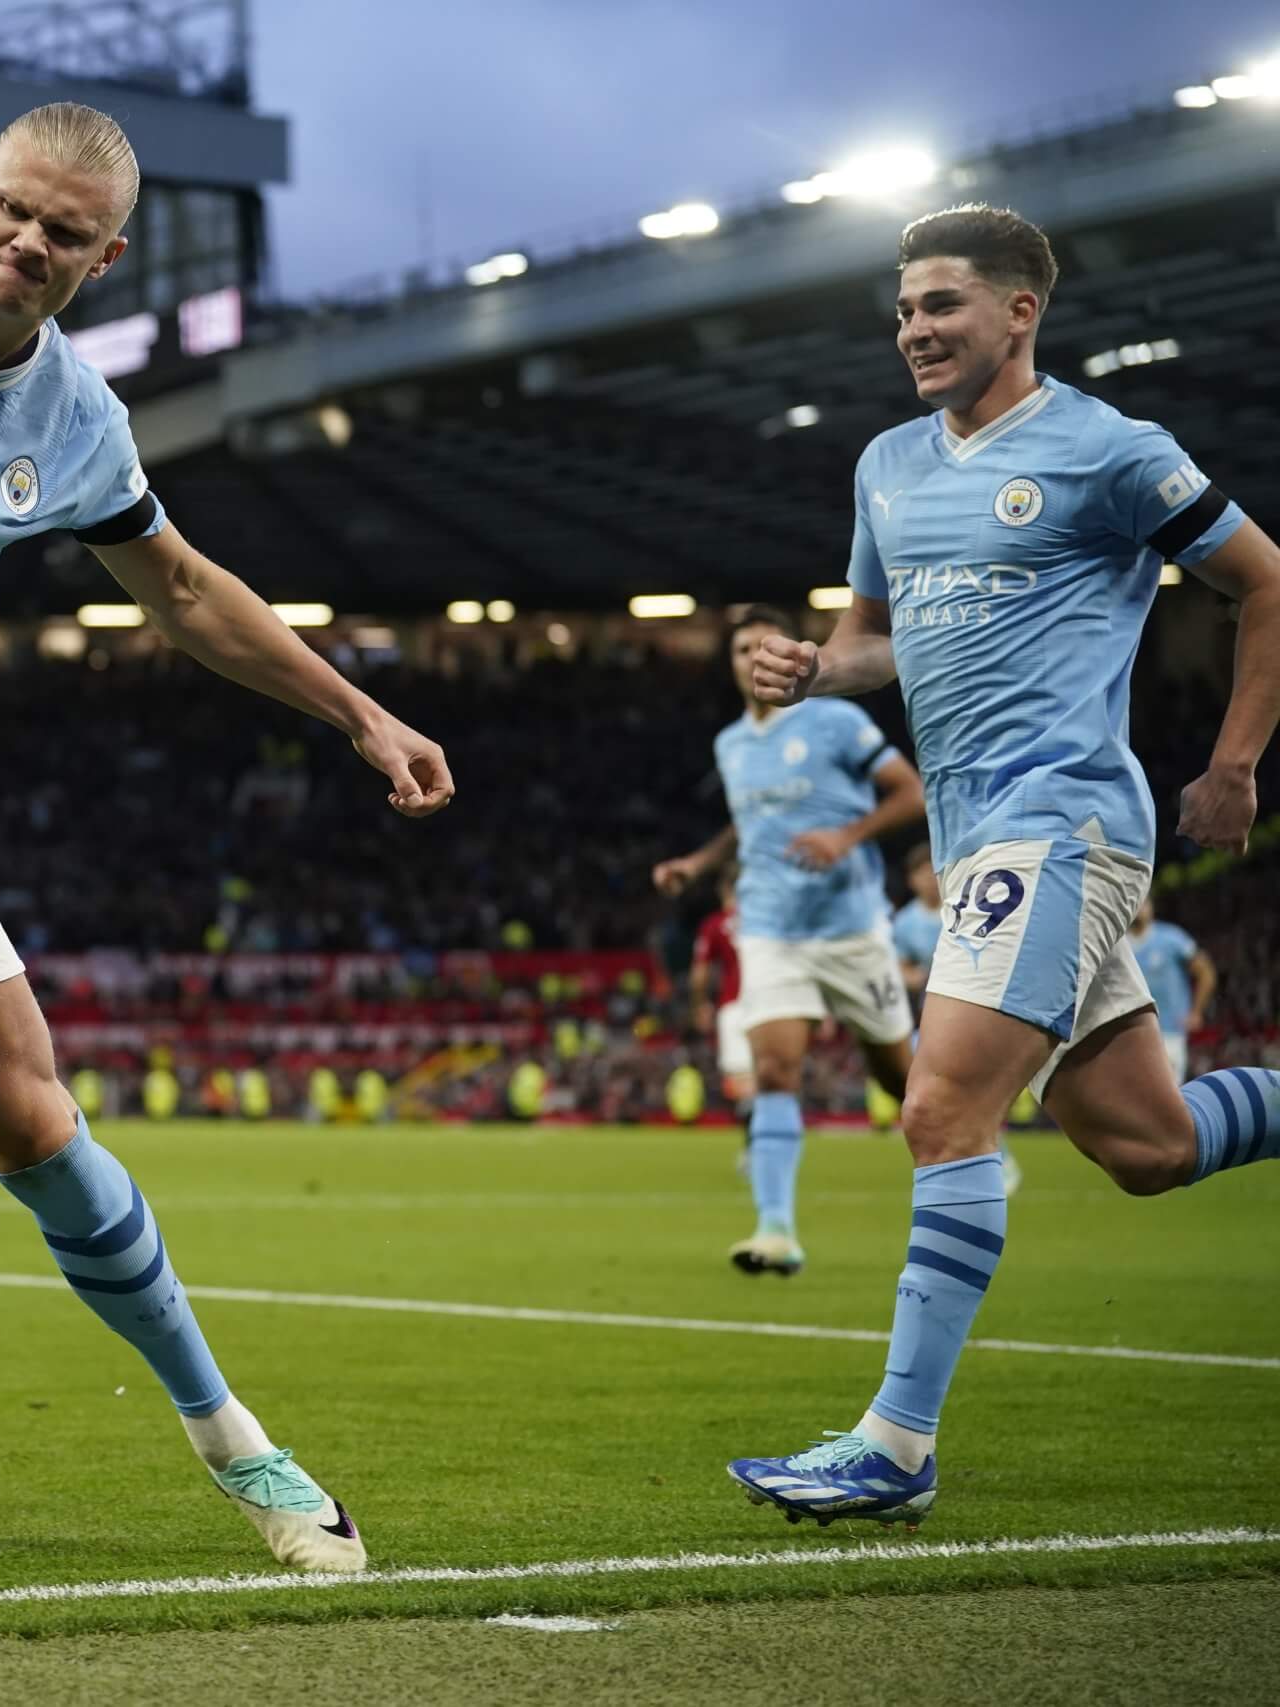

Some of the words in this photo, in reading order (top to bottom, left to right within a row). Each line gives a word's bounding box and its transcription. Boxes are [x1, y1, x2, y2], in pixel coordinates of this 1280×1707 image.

[888, 564, 1037, 598] TIHAD
[948, 868, 1025, 938] 19
[898, 1287, 932, 1303] ITY
